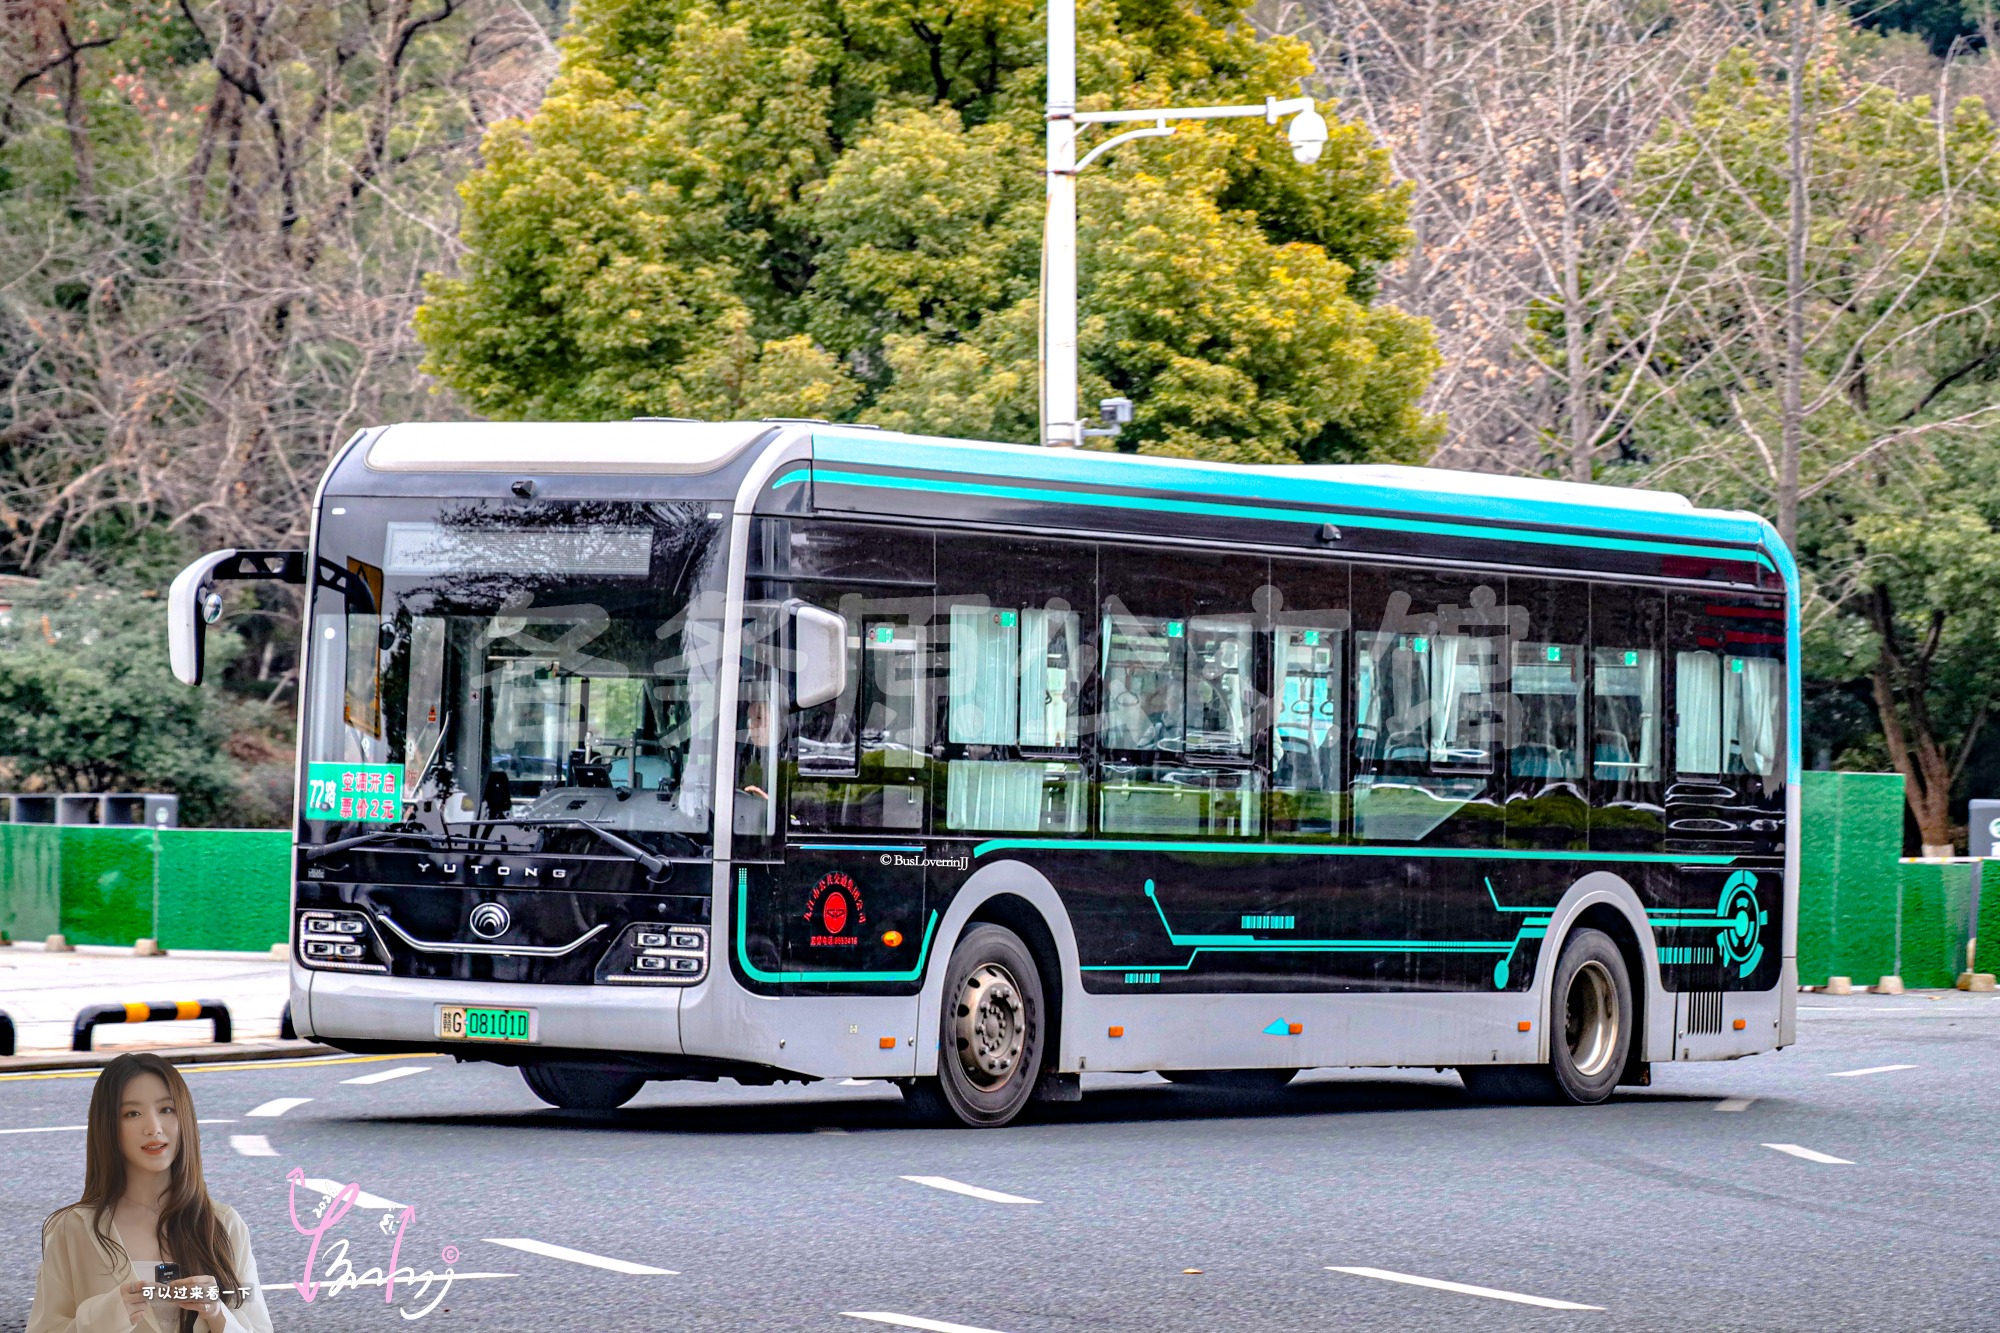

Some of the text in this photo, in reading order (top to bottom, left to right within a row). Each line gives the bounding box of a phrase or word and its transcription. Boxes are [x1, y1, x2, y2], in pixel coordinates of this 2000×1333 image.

[309, 779, 337, 809] 72路
[341, 771, 396, 796] 空调开启
[340, 797, 395, 819] 票价2元
[417, 863, 567, 878] YUTONG
